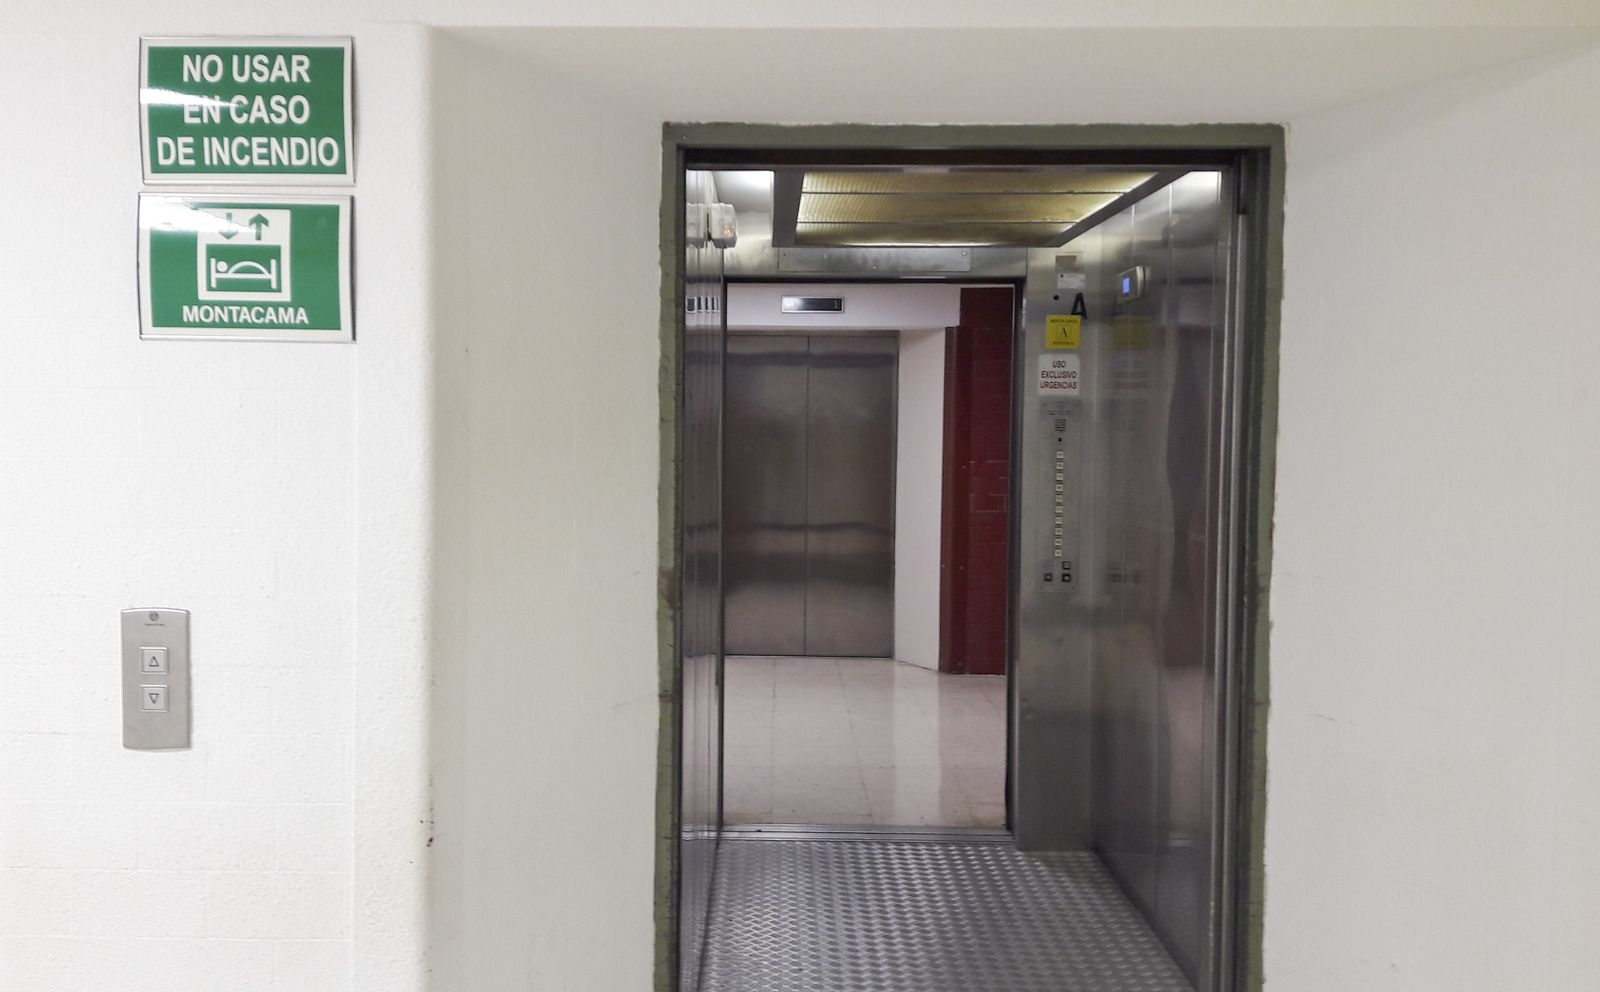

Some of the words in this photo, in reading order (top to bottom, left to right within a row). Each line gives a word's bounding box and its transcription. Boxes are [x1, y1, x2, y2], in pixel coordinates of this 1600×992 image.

[183, 54, 223, 83] NO
[232, 54, 311, 83] USAR
[183, 95, 221, 125] EN
[229, 94, 310, 125] CASO
[157, 136, 196, 166] DE
[203, 136, 339, 167] INCENDIO
[182, 304, 310, 325] MONTACAMA
[1070, 292, 1088, 319] A
[1041, 371, 1077, 379] EXCLUSIVO
[1052, 360, 1067, 368] USO
[1040, 381, 1077, 390] URGENCIAS
